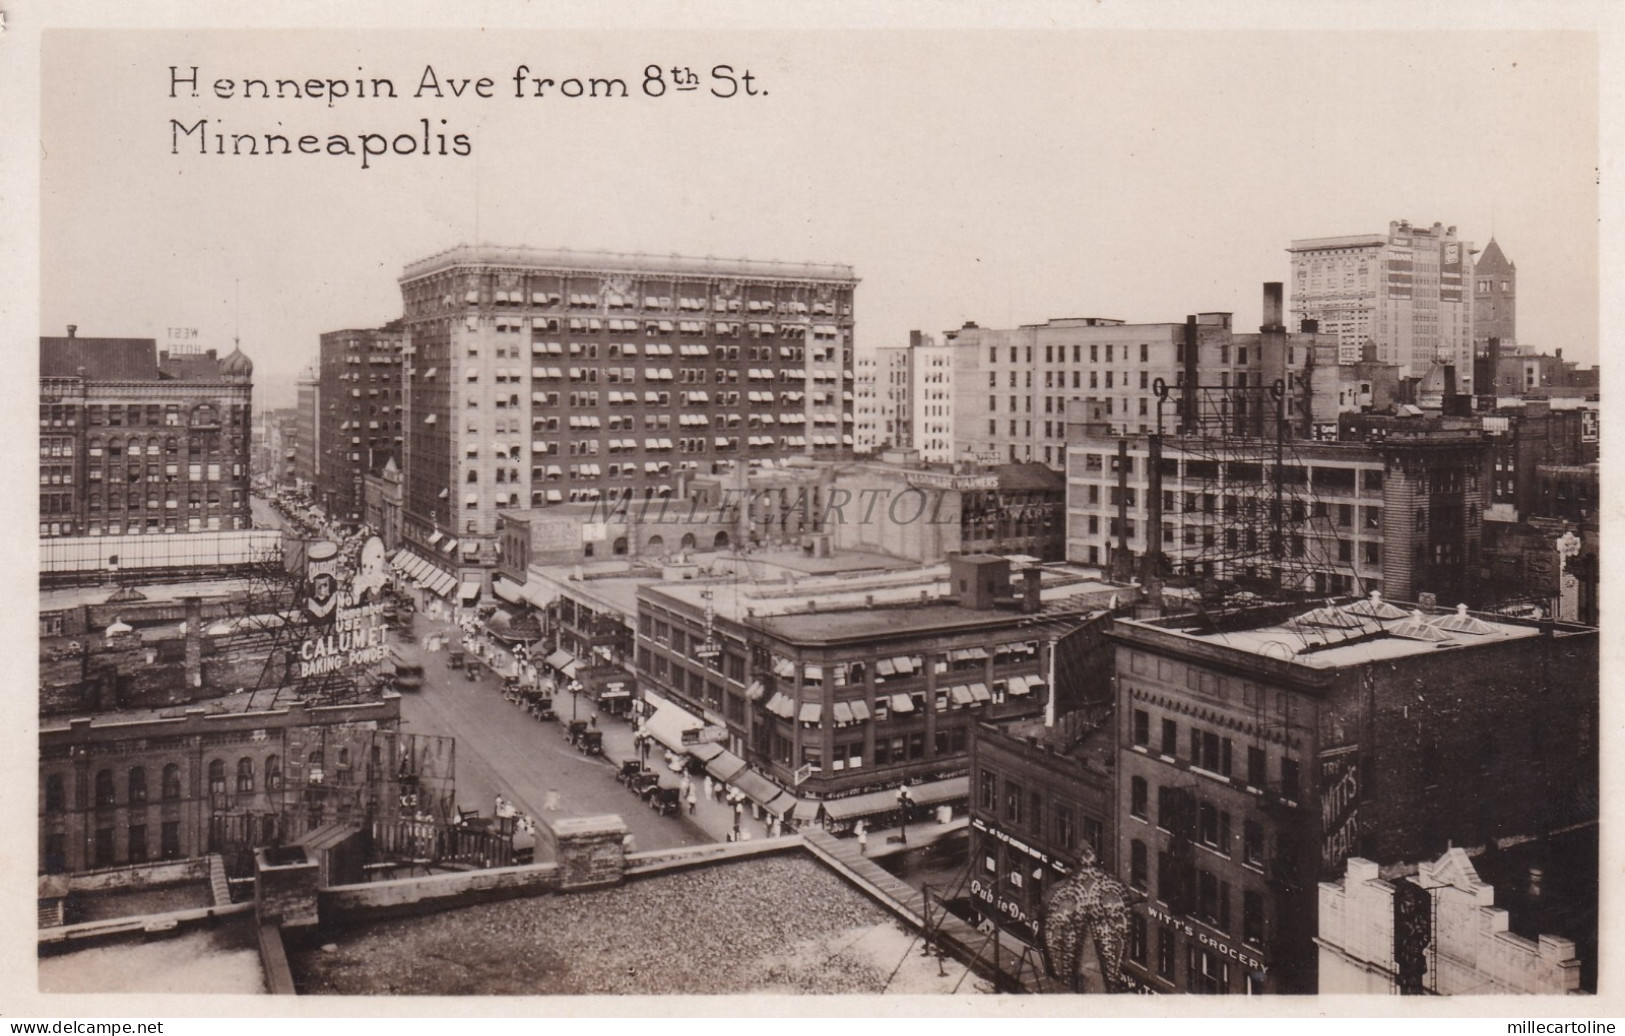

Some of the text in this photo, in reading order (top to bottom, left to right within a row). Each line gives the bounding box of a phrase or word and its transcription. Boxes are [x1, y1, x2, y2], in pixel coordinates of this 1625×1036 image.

[302, 624, 389, 660] CALUMET
[336, 618, 361, 633] USE
[301, 645, 390, 678] BAKING POWDER
[970, 879, 1008, 913] Pubic
[1147, 906, 1269, 974] WITT'S GROCERY
